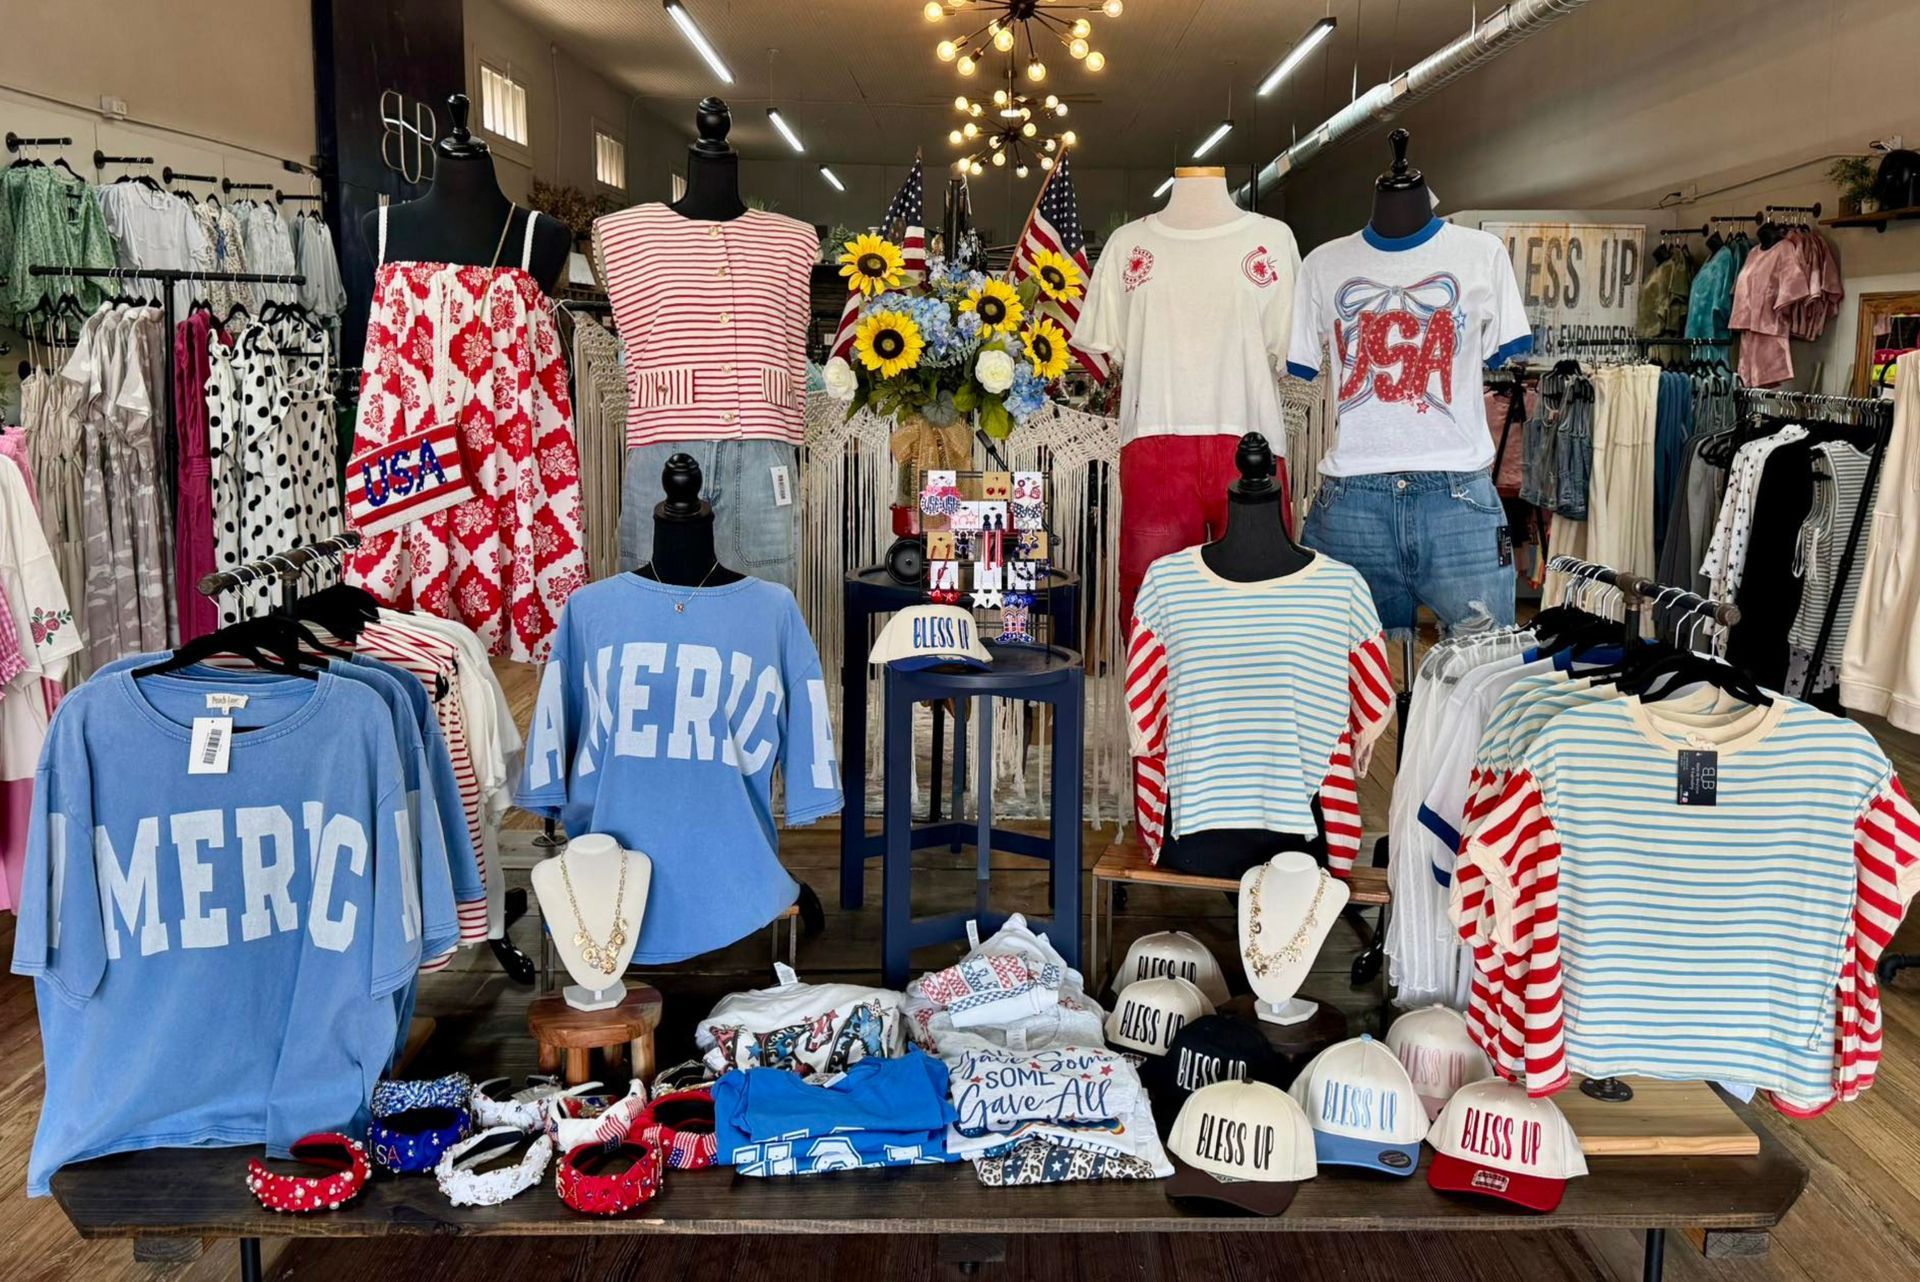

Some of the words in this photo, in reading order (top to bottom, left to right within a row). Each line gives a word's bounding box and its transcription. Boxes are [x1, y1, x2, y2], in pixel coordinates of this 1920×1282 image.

[1599, 236, 1638, 309] UP
[1333, 308, 1454, 405] USA
[362, 438, 448, 507] USA
[913, 616, 955, 649] BLESS
[957, 617, 970, 651] UP
[1136, 955, 1177, 983] BLESS
[1180, 960, 1197, 985] UP
[1119, 1000, 1161, 1046] BLESS
[985, 1067, 1056, 1090] SOME
[1176, 1047, 1221, 1092] BLESS
[957, 1083, 1044, 1130] Gave
[1044, 1078, 1113, 1130] All
[1322, 1079, 1374, 1130] BLESS
[1379, 1088, 1398, 1134] UP
[1196, 1112, 1248, 1167] BLESS
[1253, 1124, 1275, 1171] UP
[1460, 1107, 1514, 1161] BLESS
[1520, 1119, 1542, 1166] UP
